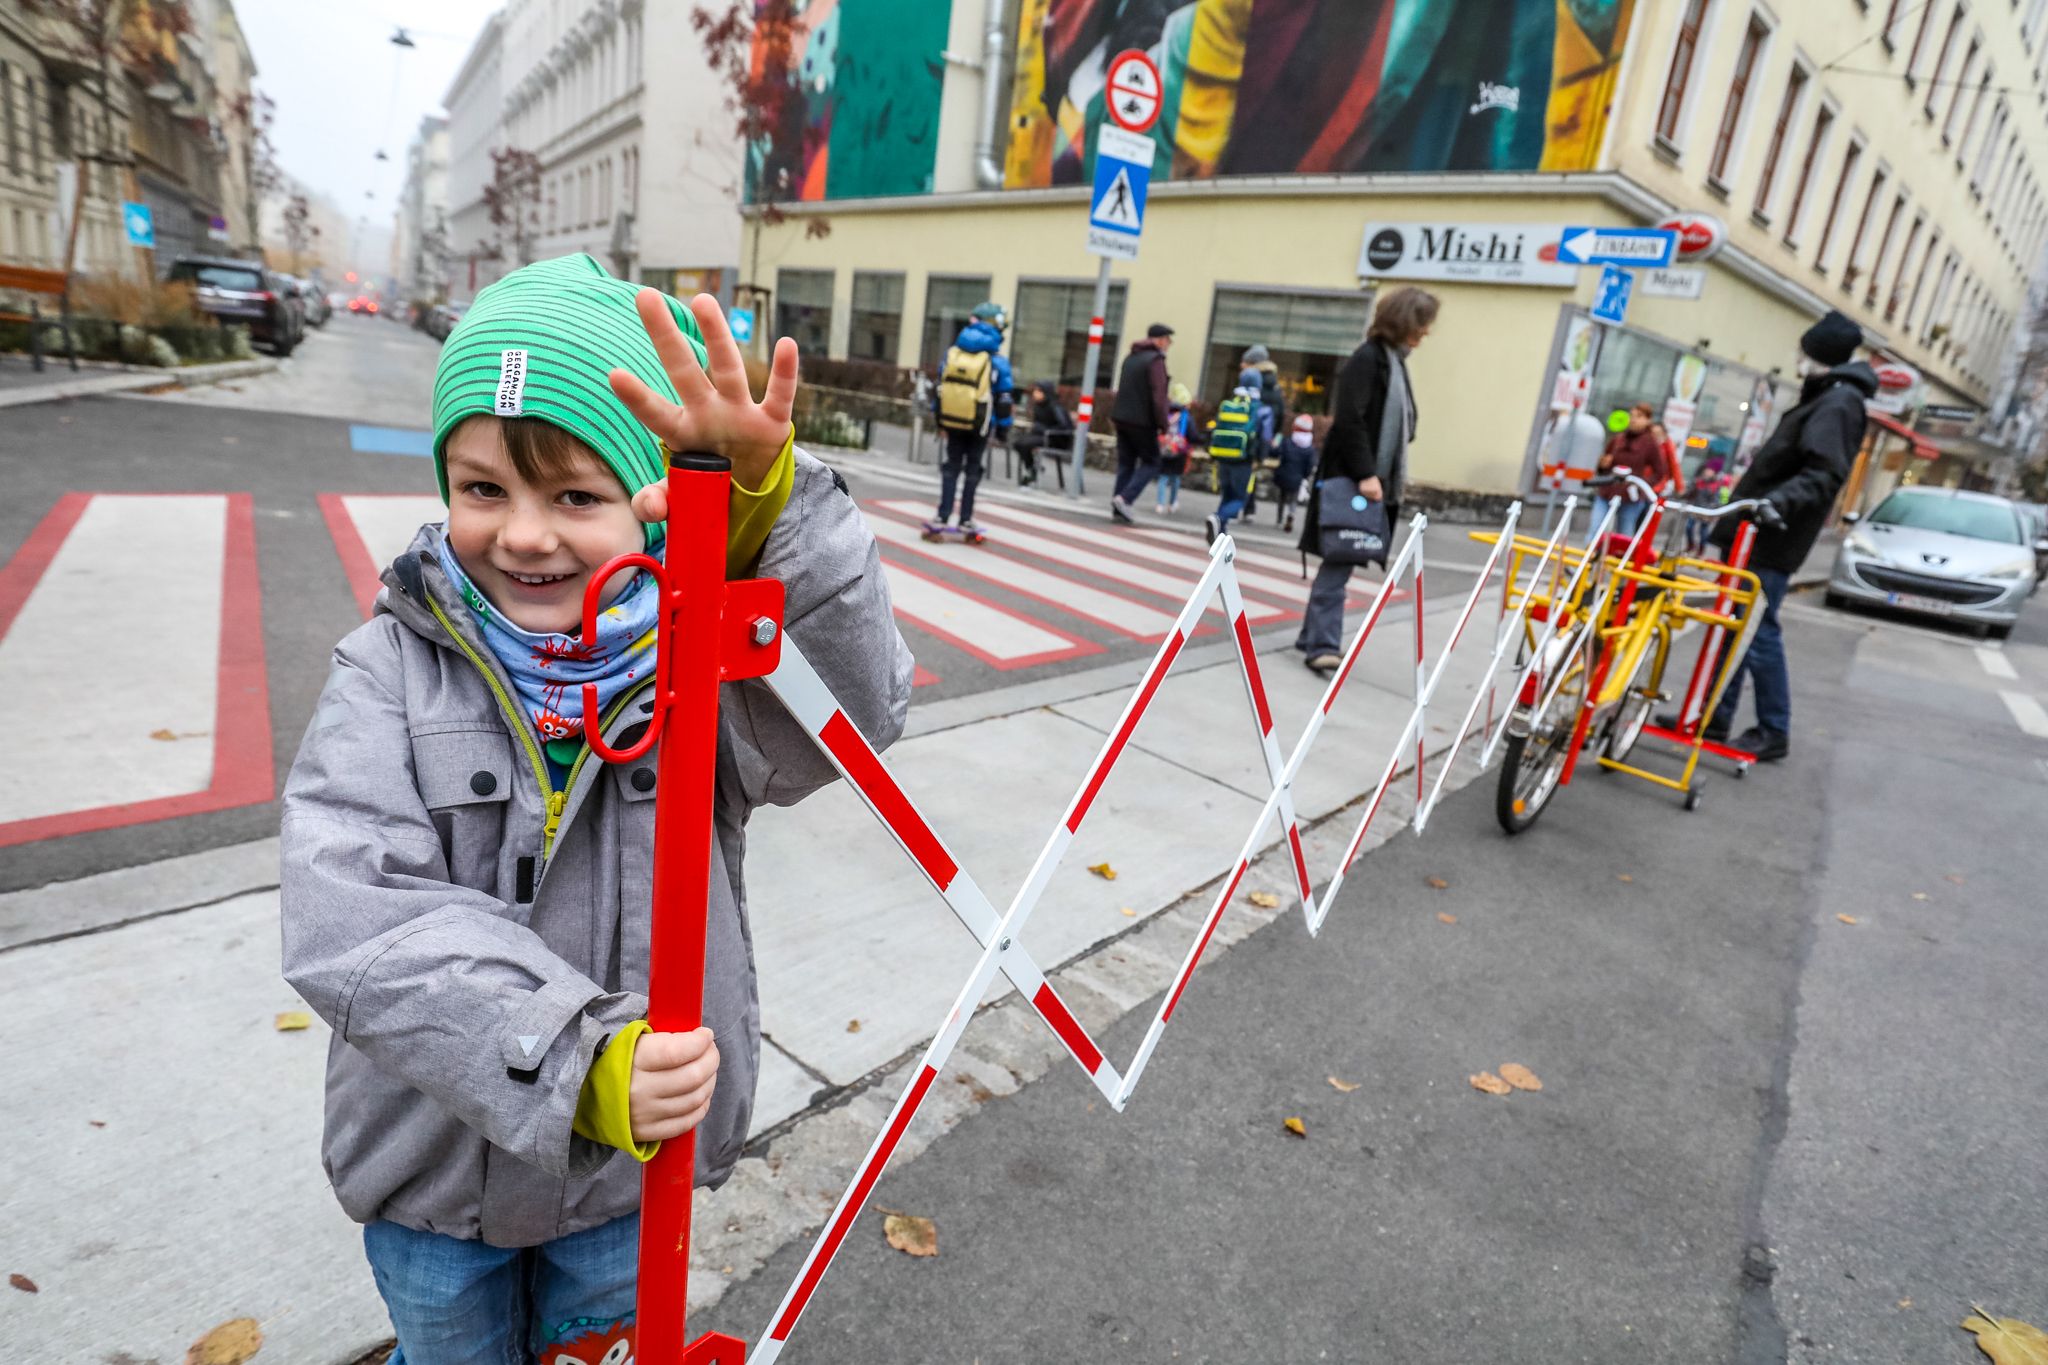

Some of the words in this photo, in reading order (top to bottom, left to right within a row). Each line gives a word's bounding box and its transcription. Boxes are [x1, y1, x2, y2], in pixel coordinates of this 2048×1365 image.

[1415, 227, 1523, 261] Mishi
[1594, 238, 1658, 255] EINBAHN
[500, 351, 514, 409] COLLECTION
[508, 351, 522, 408] GEGGAMOJA
